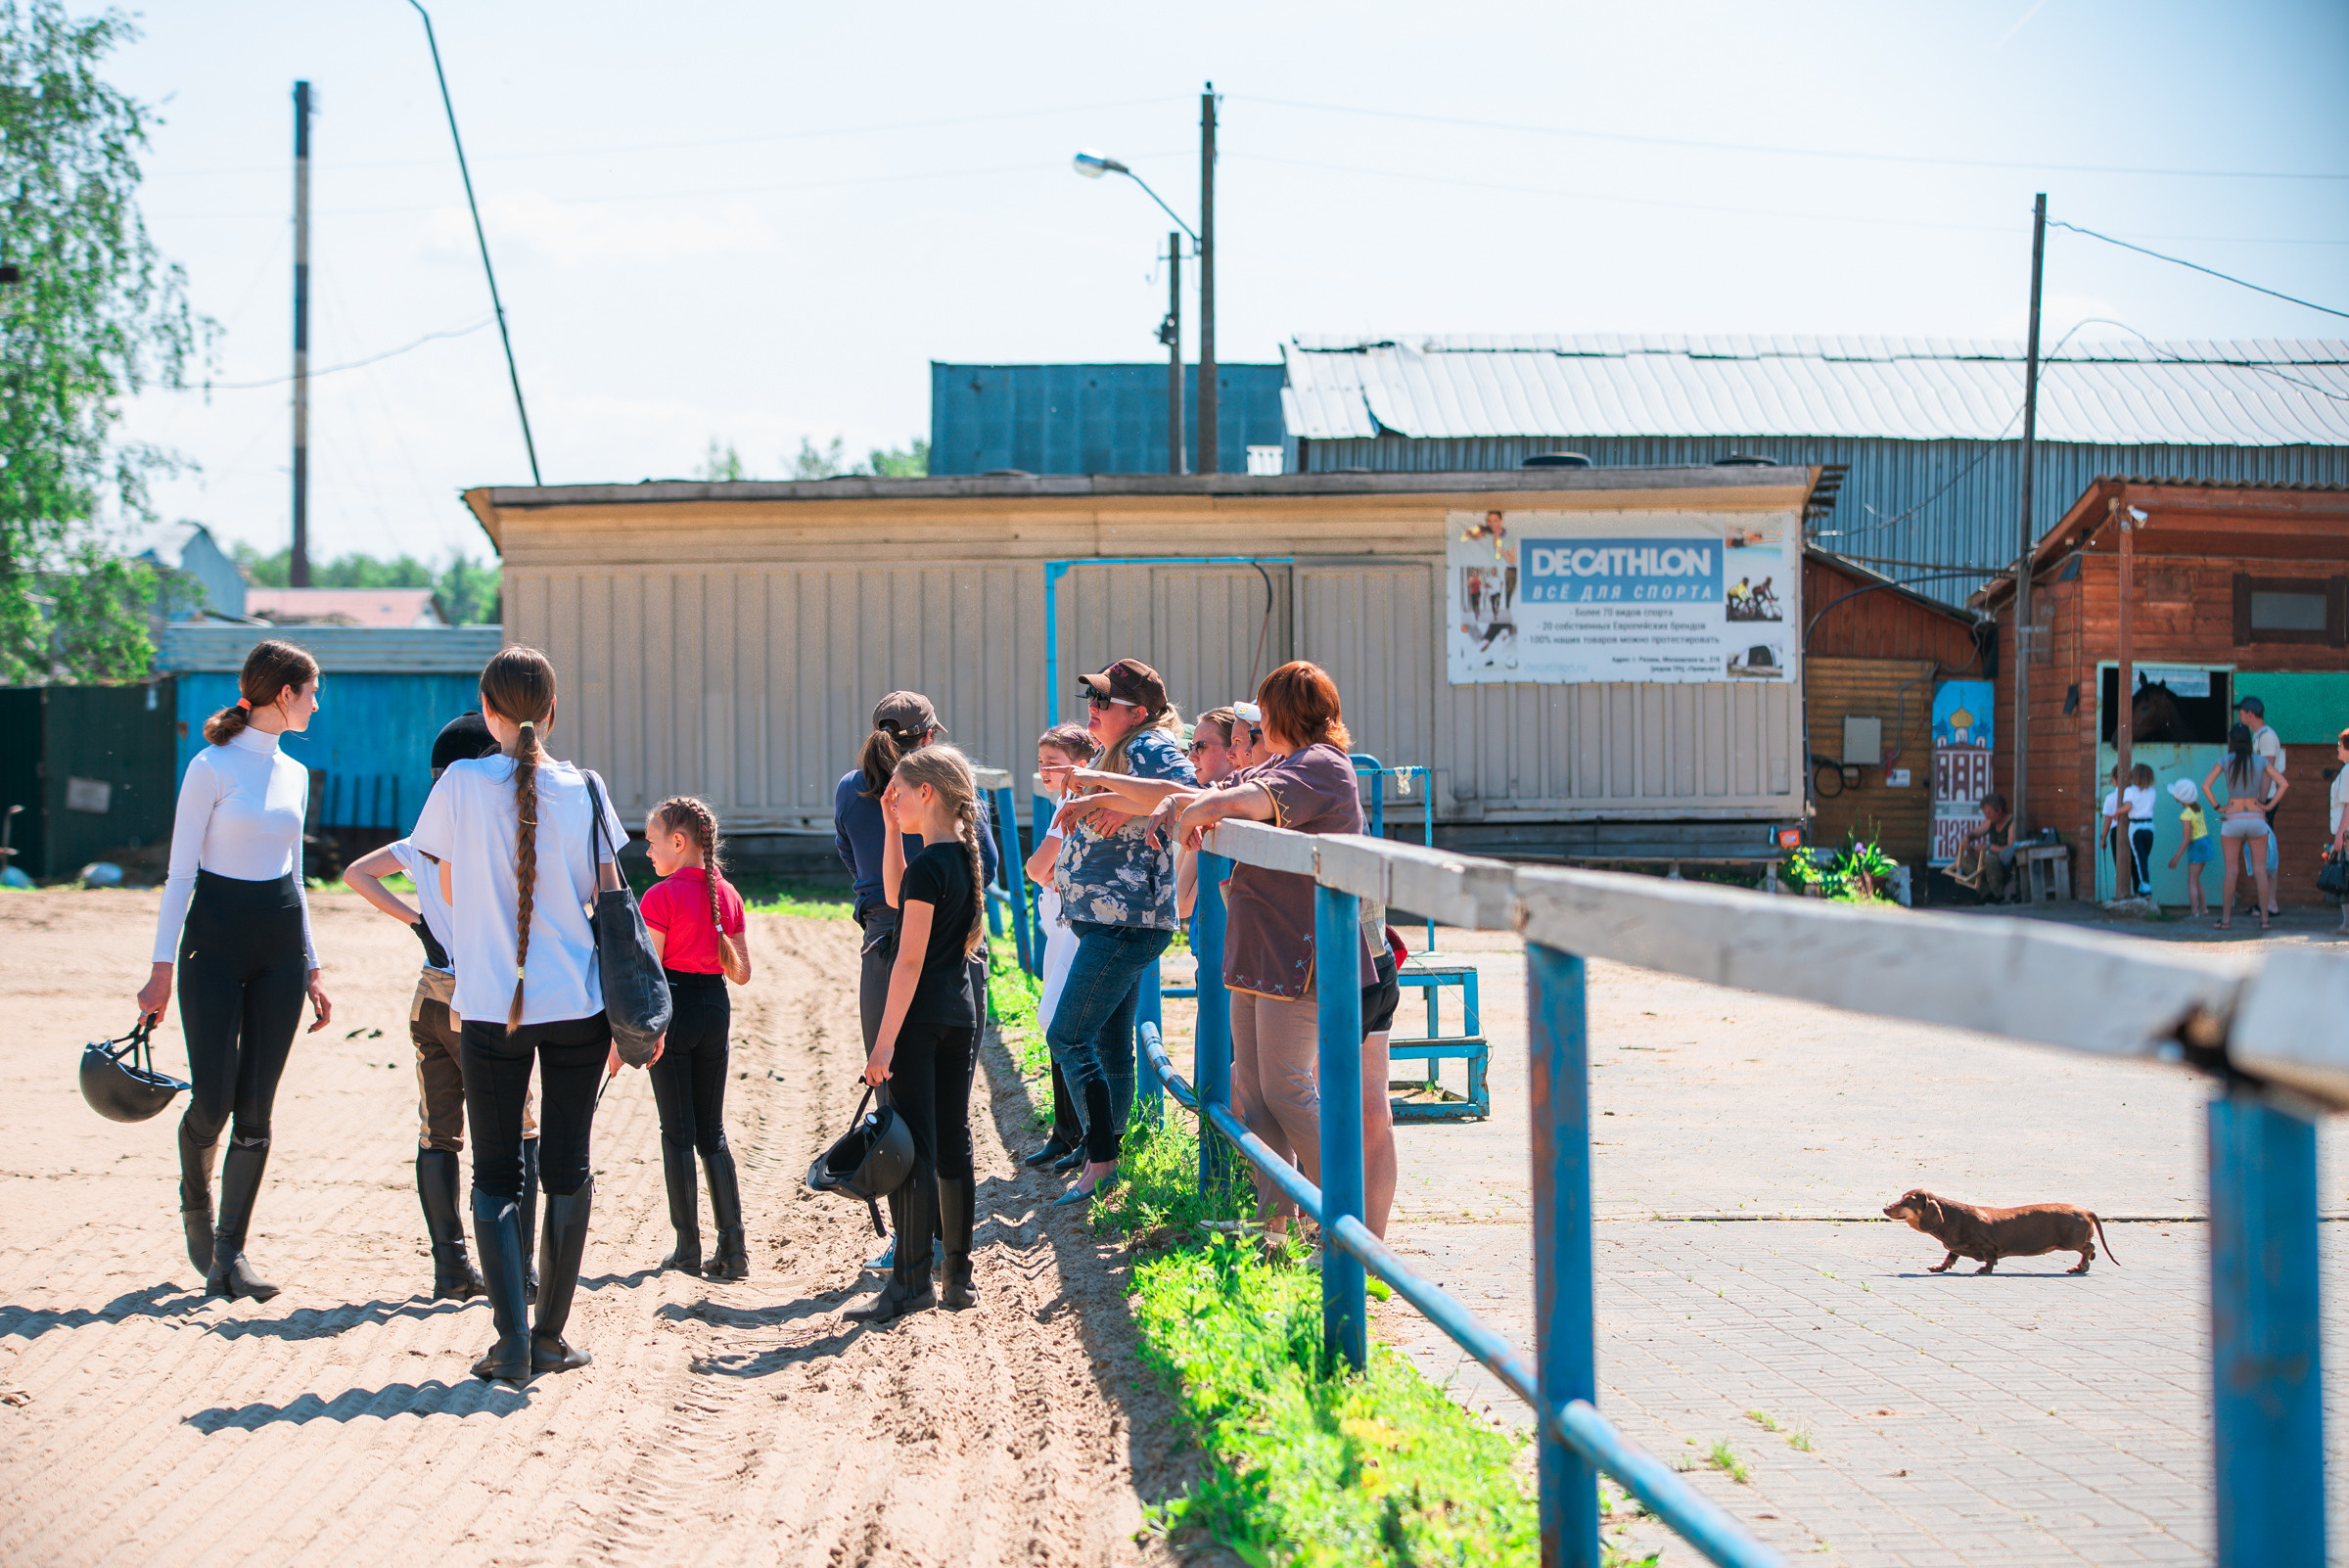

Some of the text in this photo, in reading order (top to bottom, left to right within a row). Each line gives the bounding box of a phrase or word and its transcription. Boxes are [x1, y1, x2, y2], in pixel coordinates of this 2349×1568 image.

[1532, 547, 1711, 576] DECATHLON
[1533, 583, 1712, 602] ВСЁ ДЛЯ СПОРТА
[1615, 609, 1641, 619] видов
[1643, 609, 1674, 619] спорта
[1554, 621, 1611, 631] собственных
[1670, 621, 1706, 631] брендов
[1530, 634, 1551, 644] 100%
[1584, 636, 1618, 645] товаров
[1651, 636, 1720, 646] протестировать
